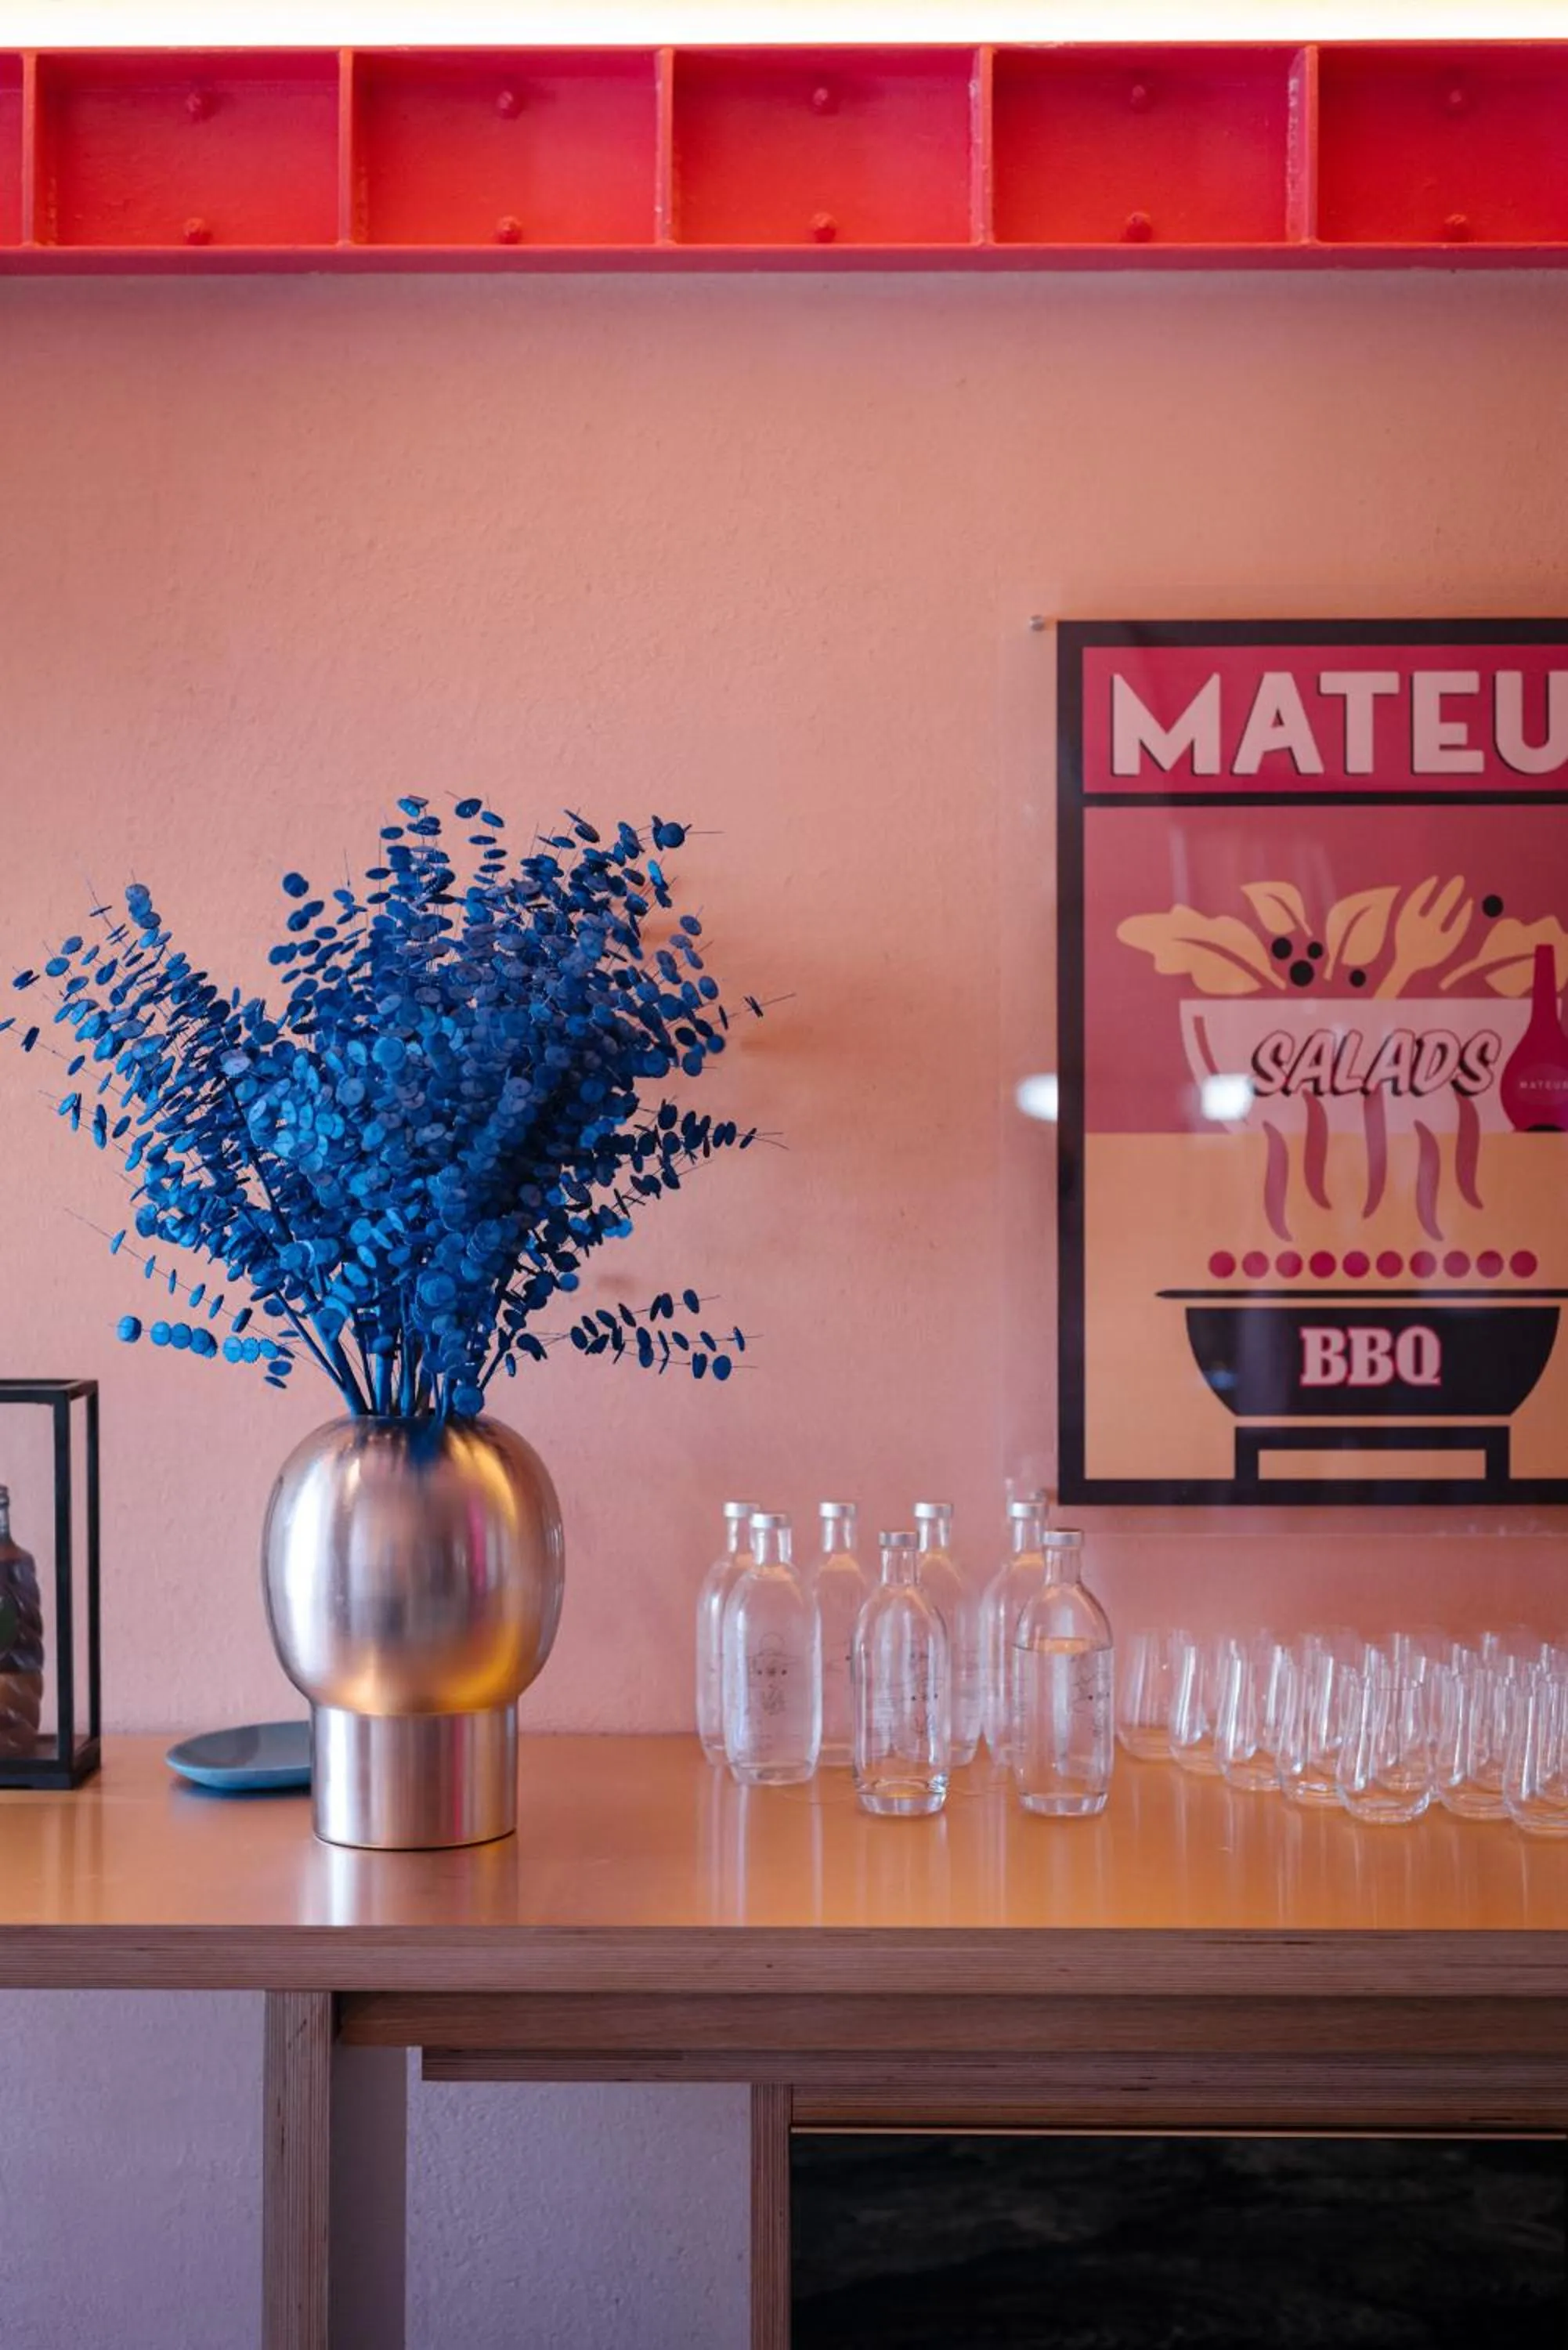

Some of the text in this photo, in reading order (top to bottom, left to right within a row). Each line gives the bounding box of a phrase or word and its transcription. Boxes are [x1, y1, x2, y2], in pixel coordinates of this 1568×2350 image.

[1111, 671, 1568, 776] MATEU
[1252, 1029, 1501, 1096] SALADS
[1299, 1325, 1442, 1386] BBQ
